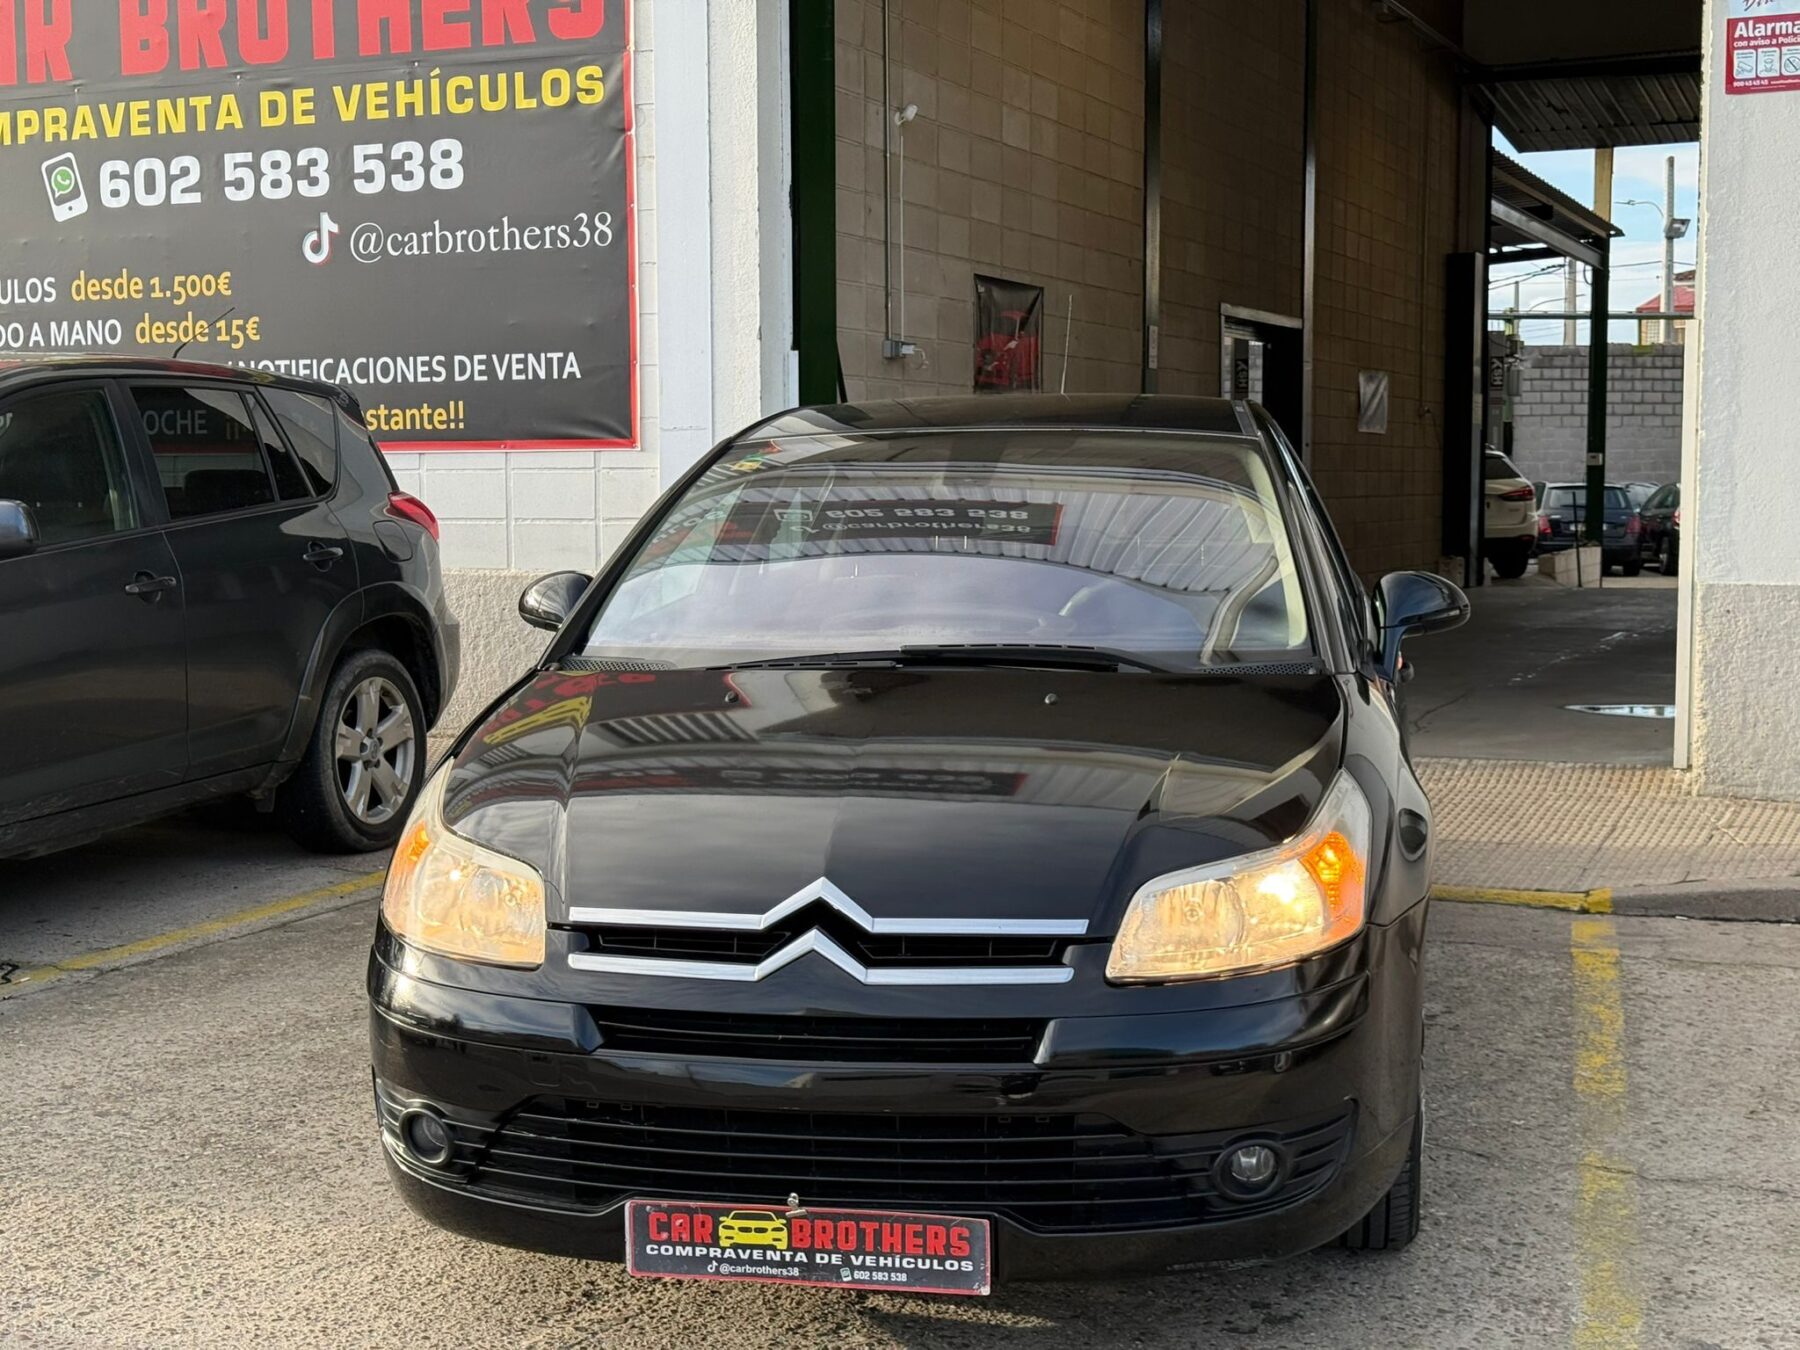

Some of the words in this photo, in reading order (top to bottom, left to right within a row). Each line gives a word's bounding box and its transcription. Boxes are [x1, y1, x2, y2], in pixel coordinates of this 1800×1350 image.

[1734, 20, 1800, 38] Alarma
[1749, 38, 1770, 46] aviso
[260, 87, 316, 127] DE
[332, 66, 604, 122] VEHÍCULOS
[99, 155, 202, 208] 602
[223, 147, 330, 201] 583
[353, 138, 464, 194] 538
[350, 211, 613, 263] @carbrothers38
[0, 277, 57, 305] ULOS
[71, 268, 143, 301] desde
[150, 271, 232, 305] 1.500€
[28, 321, 45, 347] A
[50, 319, 122, 346] MANO
[135, 311, 209, 344] desde
[215, 316, 260, 349] 15€
[238, 354, 446, 385] TIFICACIONES
[454, 353, 488, 382] DE
[492, 352, 581, 380] VENTA
[364, 400, 464, 431] stante!!
[648, 1211, 713, 1243] CAR
[790, 1218, 971, 1257] BROTHERS
[645, 1244, 808, 1263] COMPRAVENTA
[815, 1252, 842, 1265] DE
[850, 1254, 974, 1272] VEHÍCULOS
[719, 1263, 799, 1277] @carbrothers38
[853, 1270, 870, 1280] 602
[872, 1271, 889, 1281] 583
[890, 1272, 907, 1282] 538
